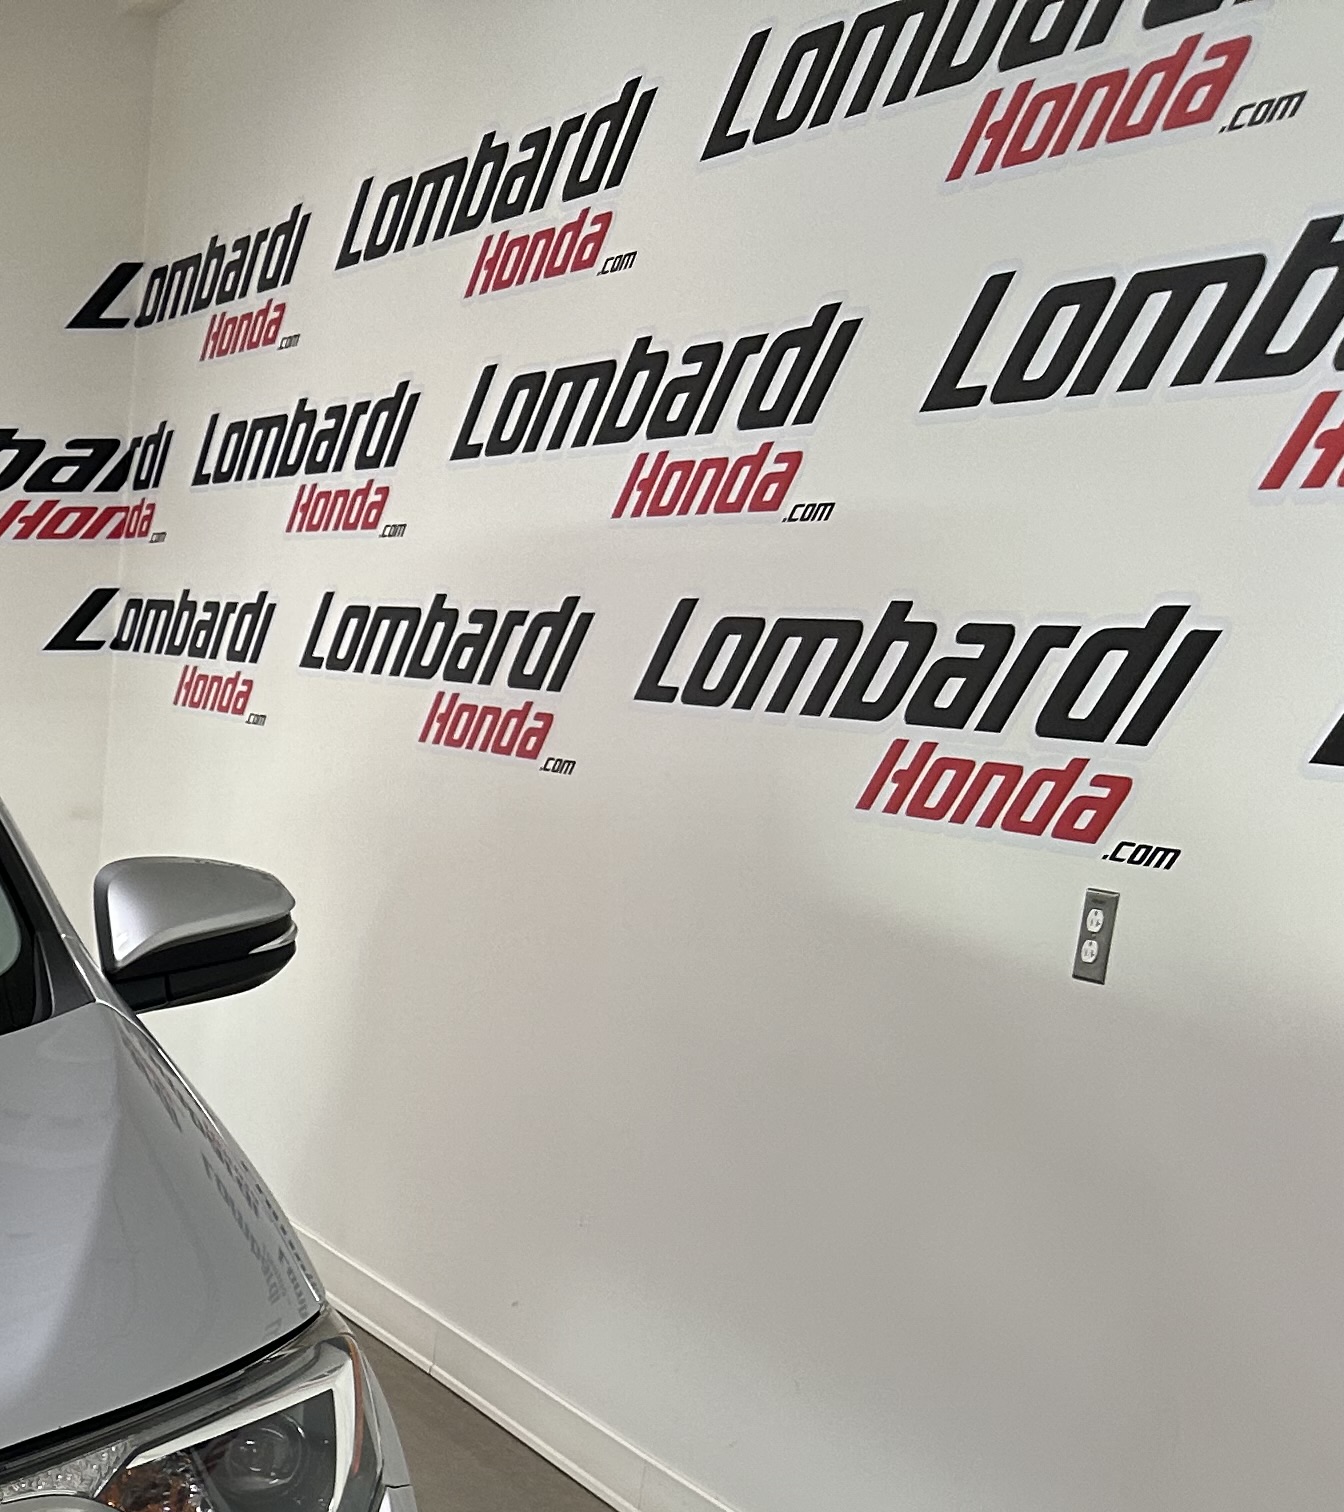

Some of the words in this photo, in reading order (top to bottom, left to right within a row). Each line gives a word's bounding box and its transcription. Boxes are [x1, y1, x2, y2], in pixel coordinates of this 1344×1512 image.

[946, 34, 1252, 182] Honda
[1218, 91, 1307, 134] .com
[333, 76, 659, 271] Lombardi
[64, 203, 312, 330] Lombardi
[464, 207, 613, 298] Honda
[597, 250, 637, 276] .com
[199, 299, 286, 357] Honda
[919, 213, 1344, 413] Lomb
[449, 301, 864, 461] Lombardi
[191, 379, 421, 487] Lombardi
[285, 479, 391, 534] Honda
[611, 441, 804, 519] Honda
[782, 502, 836, 522] .com
[42, 588, 277, 664] Lombardi
[299, 591, 597, 693] Lombardi
[172, 665, 254, 716] Honda
[633, 598, 1224, 748] Lombardi
[418, 691, 555, 760] Honda
[540, 757, 577, 775] .com
[855, 738, 1134, 845] Honda
[1101, 841, 1182, 871] .com
